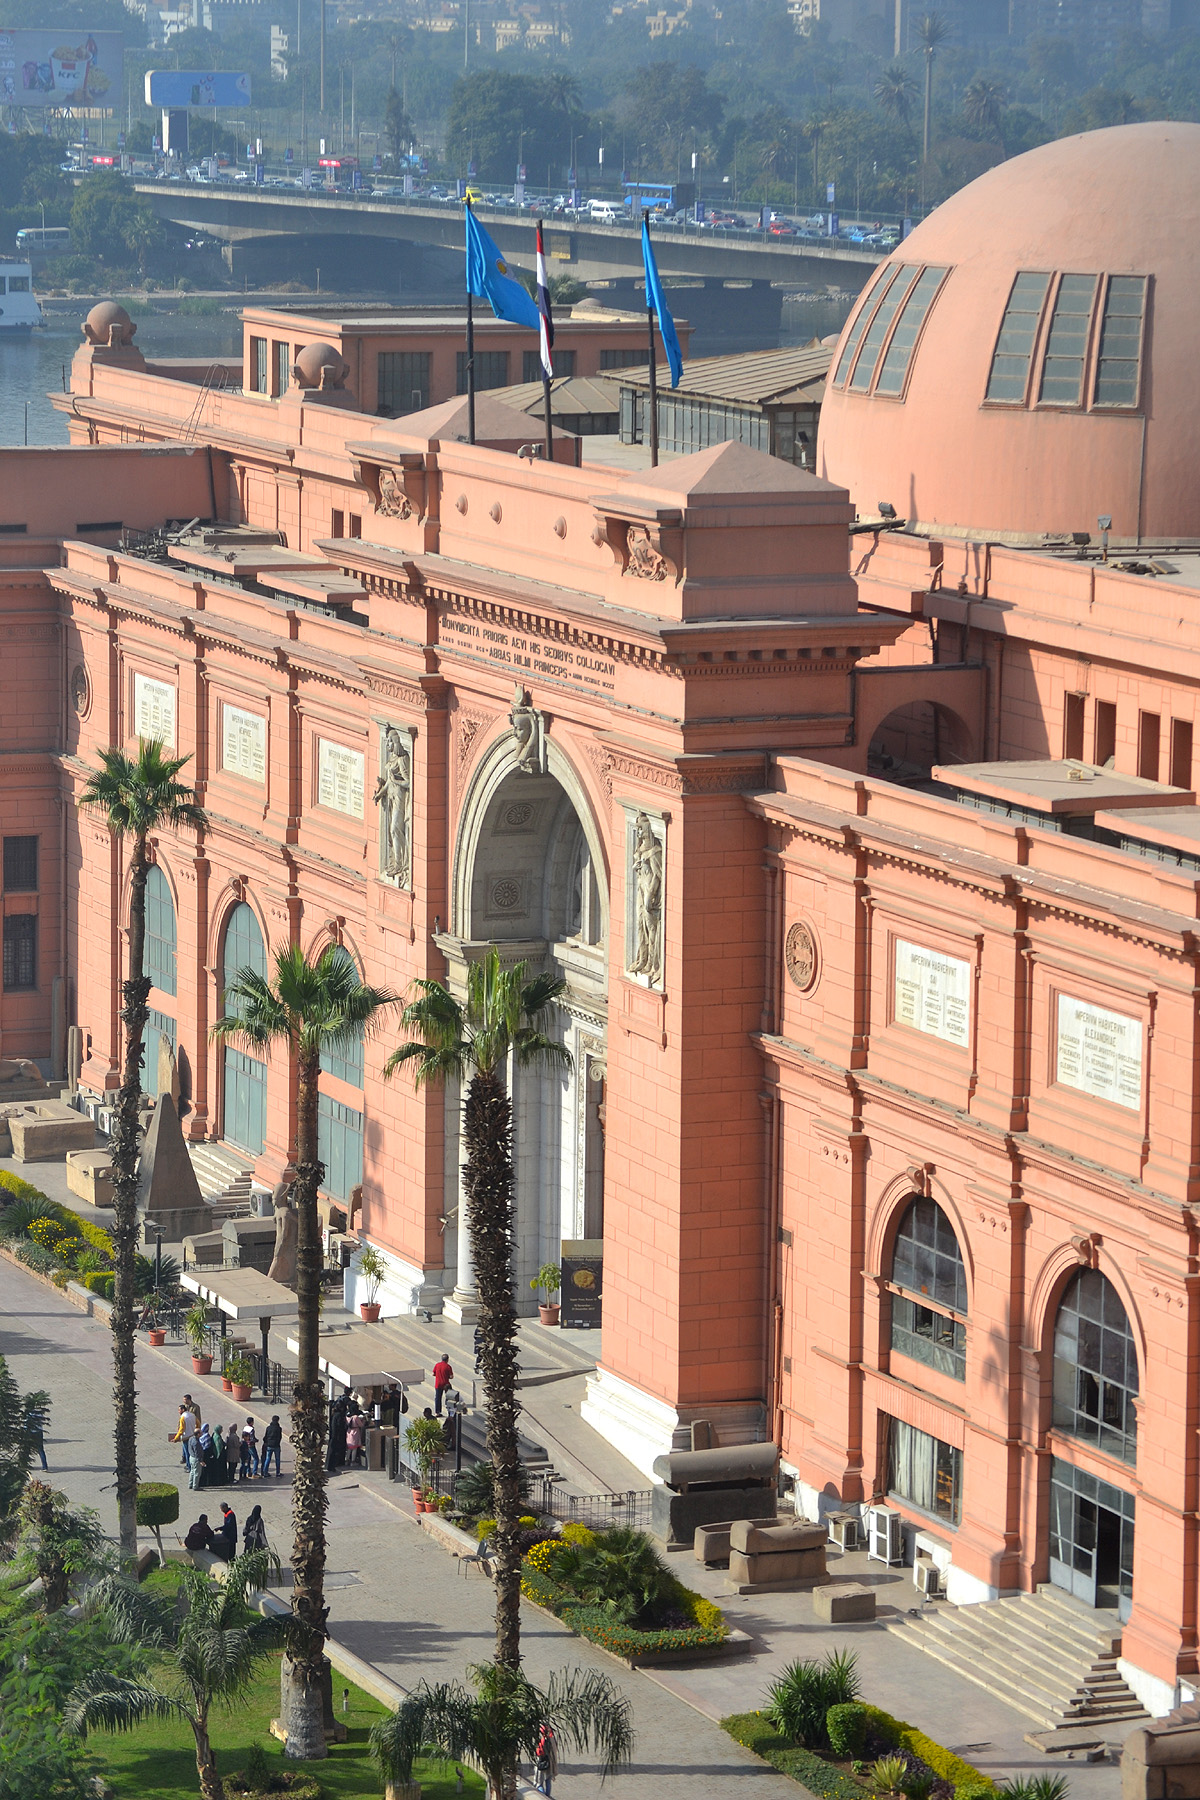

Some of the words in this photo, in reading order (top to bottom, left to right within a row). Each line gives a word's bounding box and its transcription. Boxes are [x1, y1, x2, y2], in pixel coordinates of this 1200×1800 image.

[58, 71, 79, 79] KFC
[483, 629, 508, 645] PRIORIS
[512, 637, 527, 650] AEVI
[530, 641, 541, 654] HIS
[577, 655, 615, 676] COLLOCAVI
[489, 647, 511, 662] ABBAS
[534, 658, 568, 679] PRINCEPS
